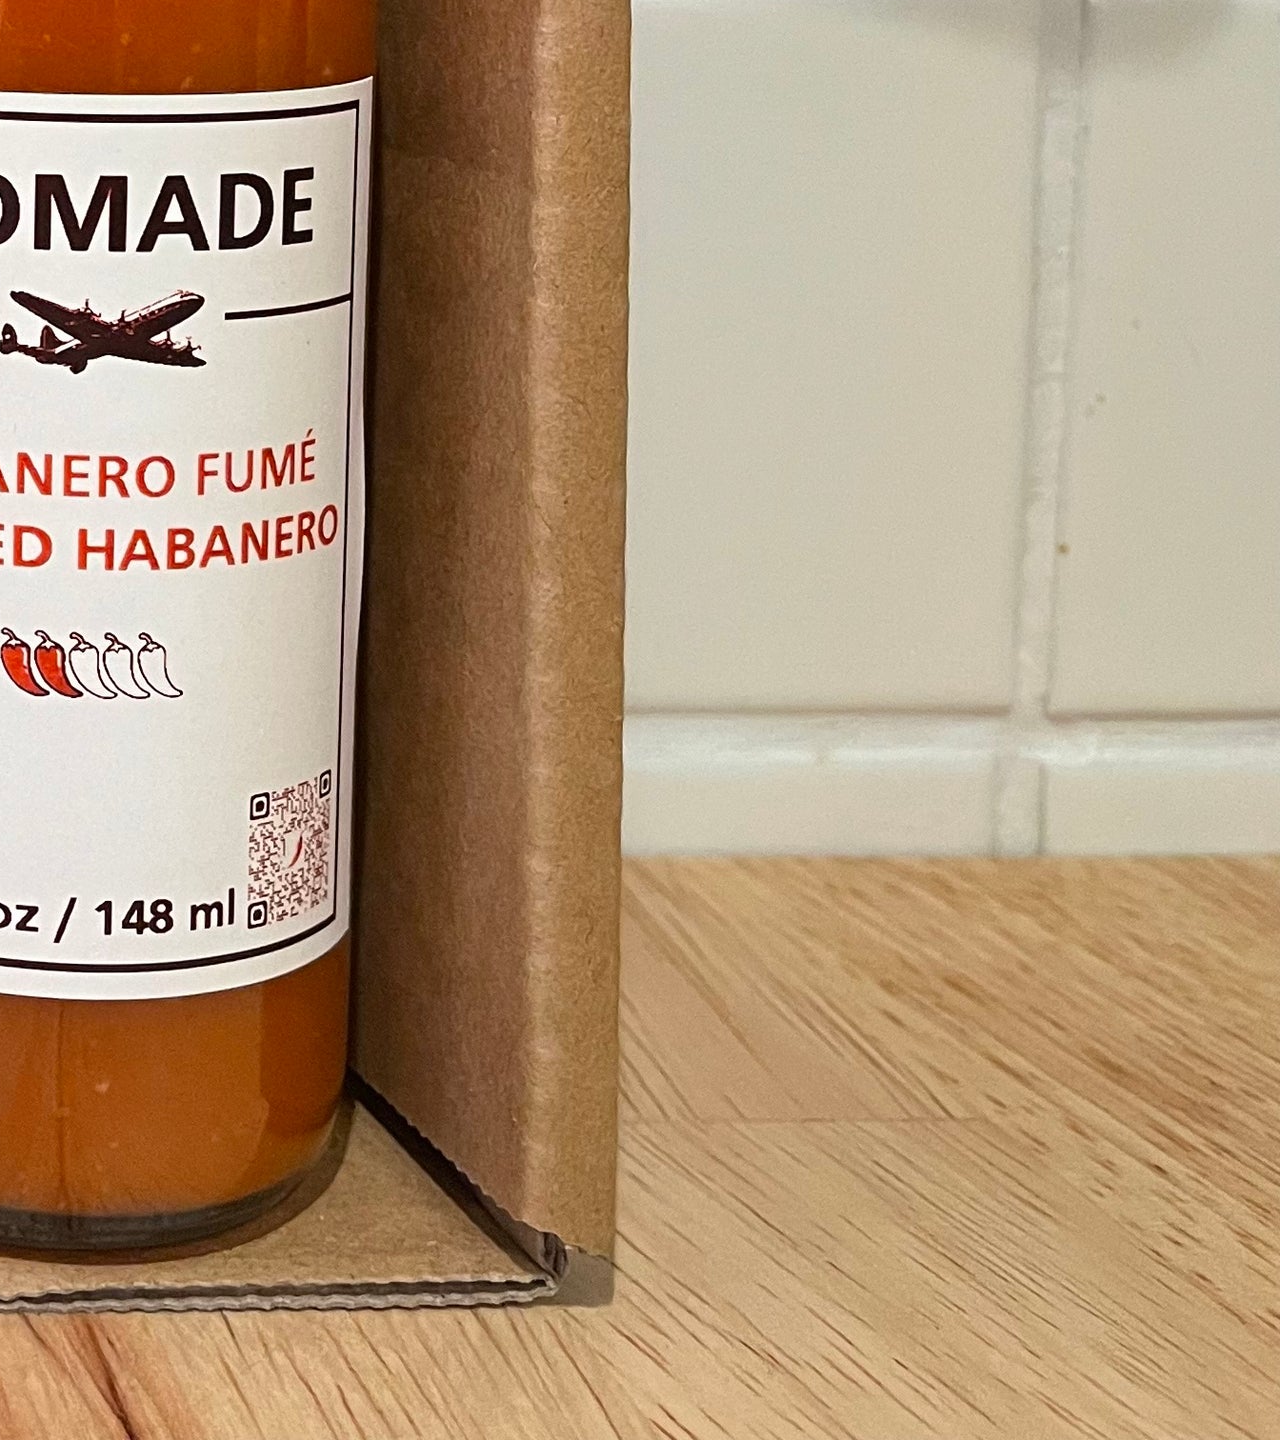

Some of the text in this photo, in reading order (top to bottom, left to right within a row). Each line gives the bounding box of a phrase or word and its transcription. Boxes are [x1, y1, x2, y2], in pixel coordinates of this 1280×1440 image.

[197, 428, 317, 496] FUMÉ
[77, 503, 339, 571] HABANERO
[53, 897, 78, 944] /
[94, 898, 174, 936] 148
[189, 887, 235, 931] ml
